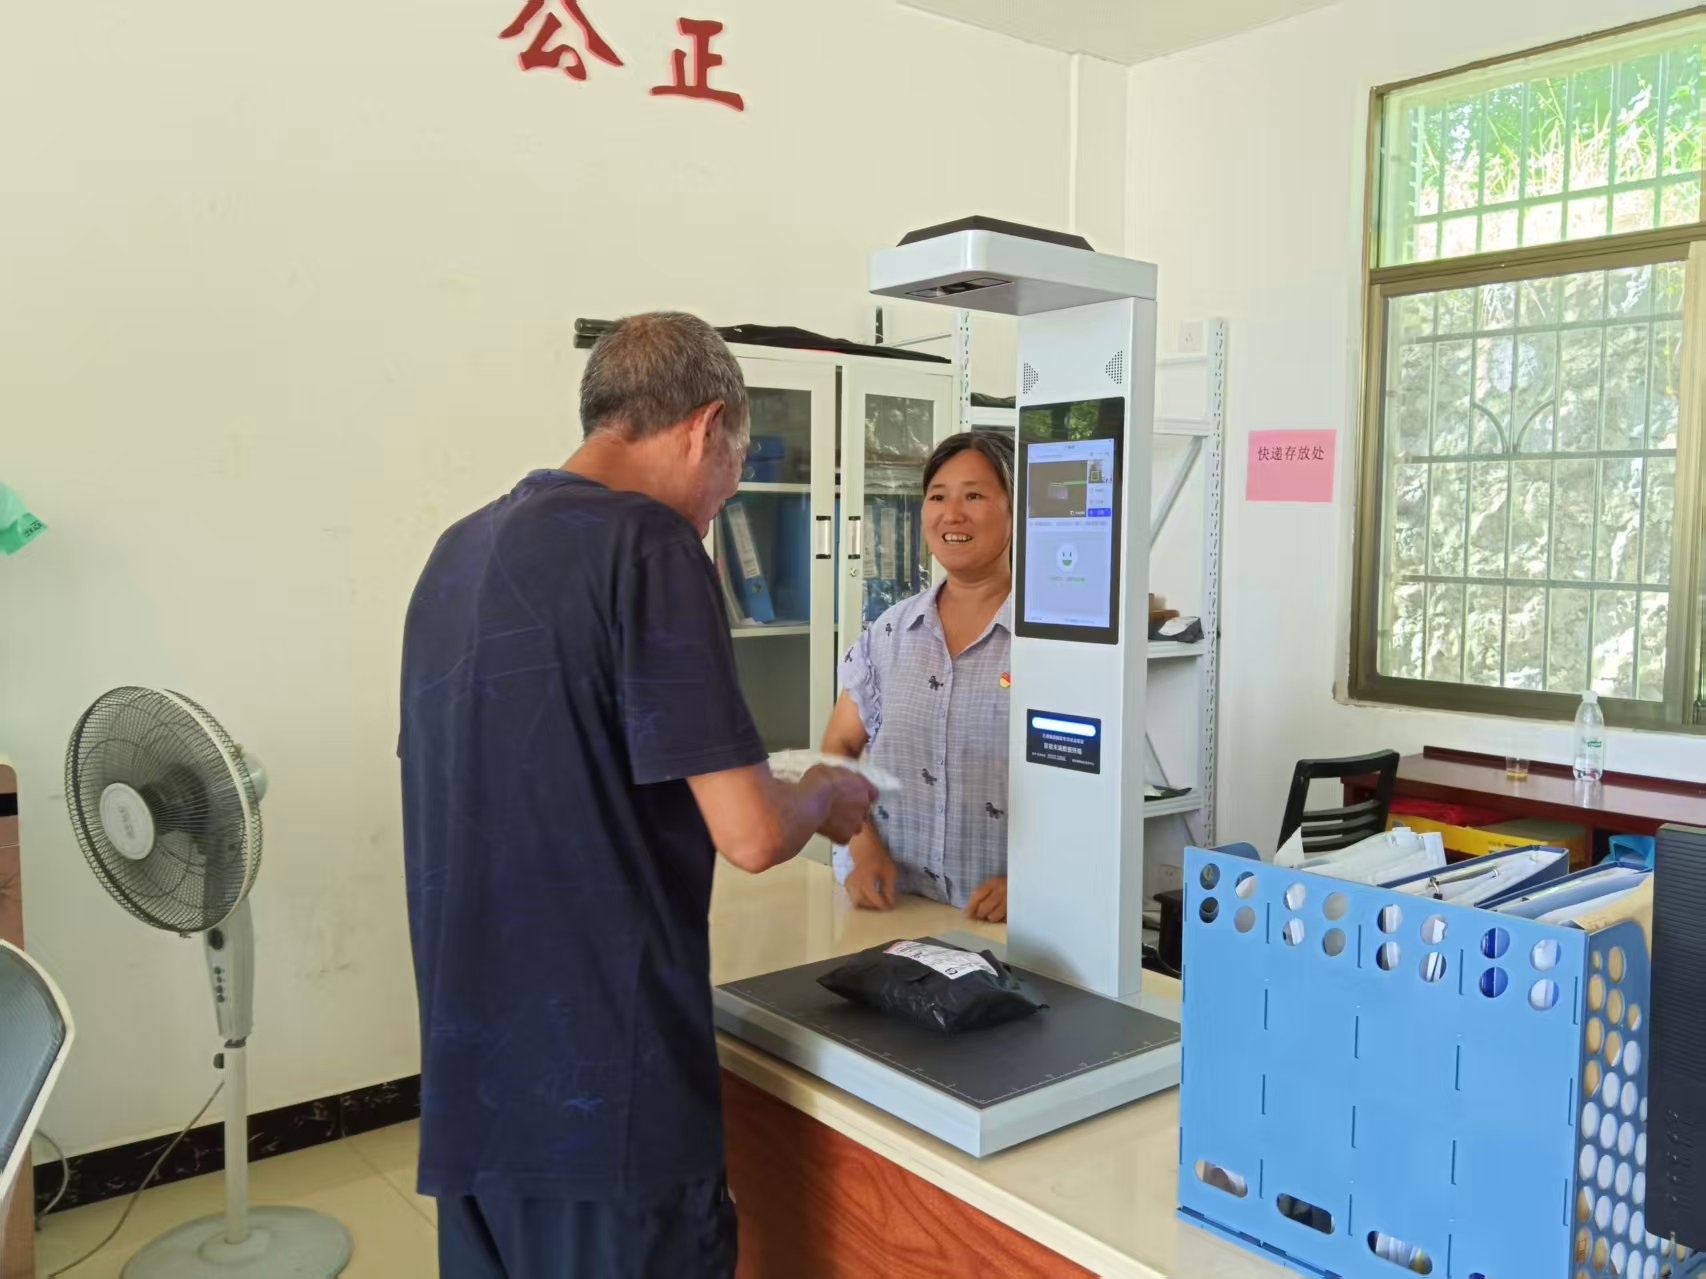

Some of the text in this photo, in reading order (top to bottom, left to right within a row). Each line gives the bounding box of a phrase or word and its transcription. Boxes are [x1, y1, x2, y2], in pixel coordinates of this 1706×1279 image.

[1258, 445, 1324, 461] 快递存放处
